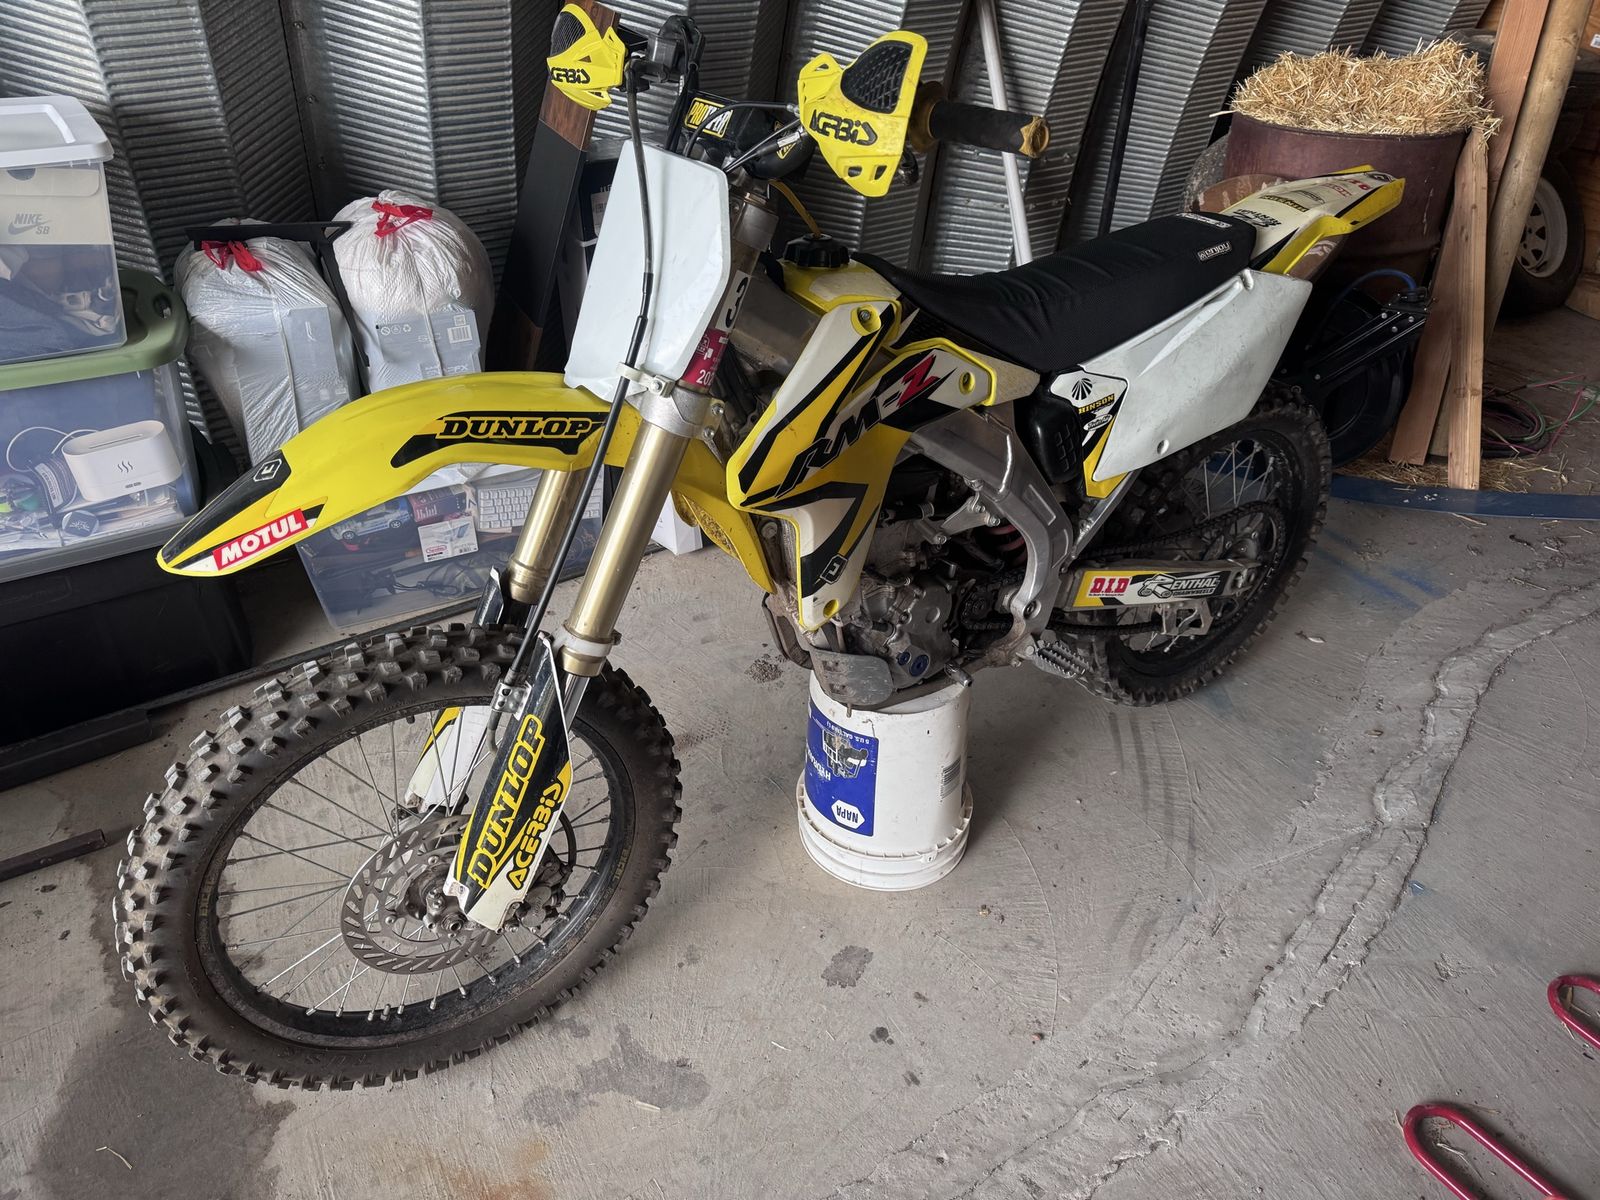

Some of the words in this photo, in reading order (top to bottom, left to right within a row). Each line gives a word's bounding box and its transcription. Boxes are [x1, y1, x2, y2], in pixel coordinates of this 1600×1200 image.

[14, 213, 43, 225] NIKE
[35, 225, 50, 235] SB
[1078, 395, 1114, 414] HINSON
[437, 417, 592, 439] DUNLOP
[221, 514, 302, 566] MOTUL
[467, 714, 545, 889] DUNLOP
[836, 805, 859, 823] NAPA
[507, 782, 561, 889] ACERBIS
